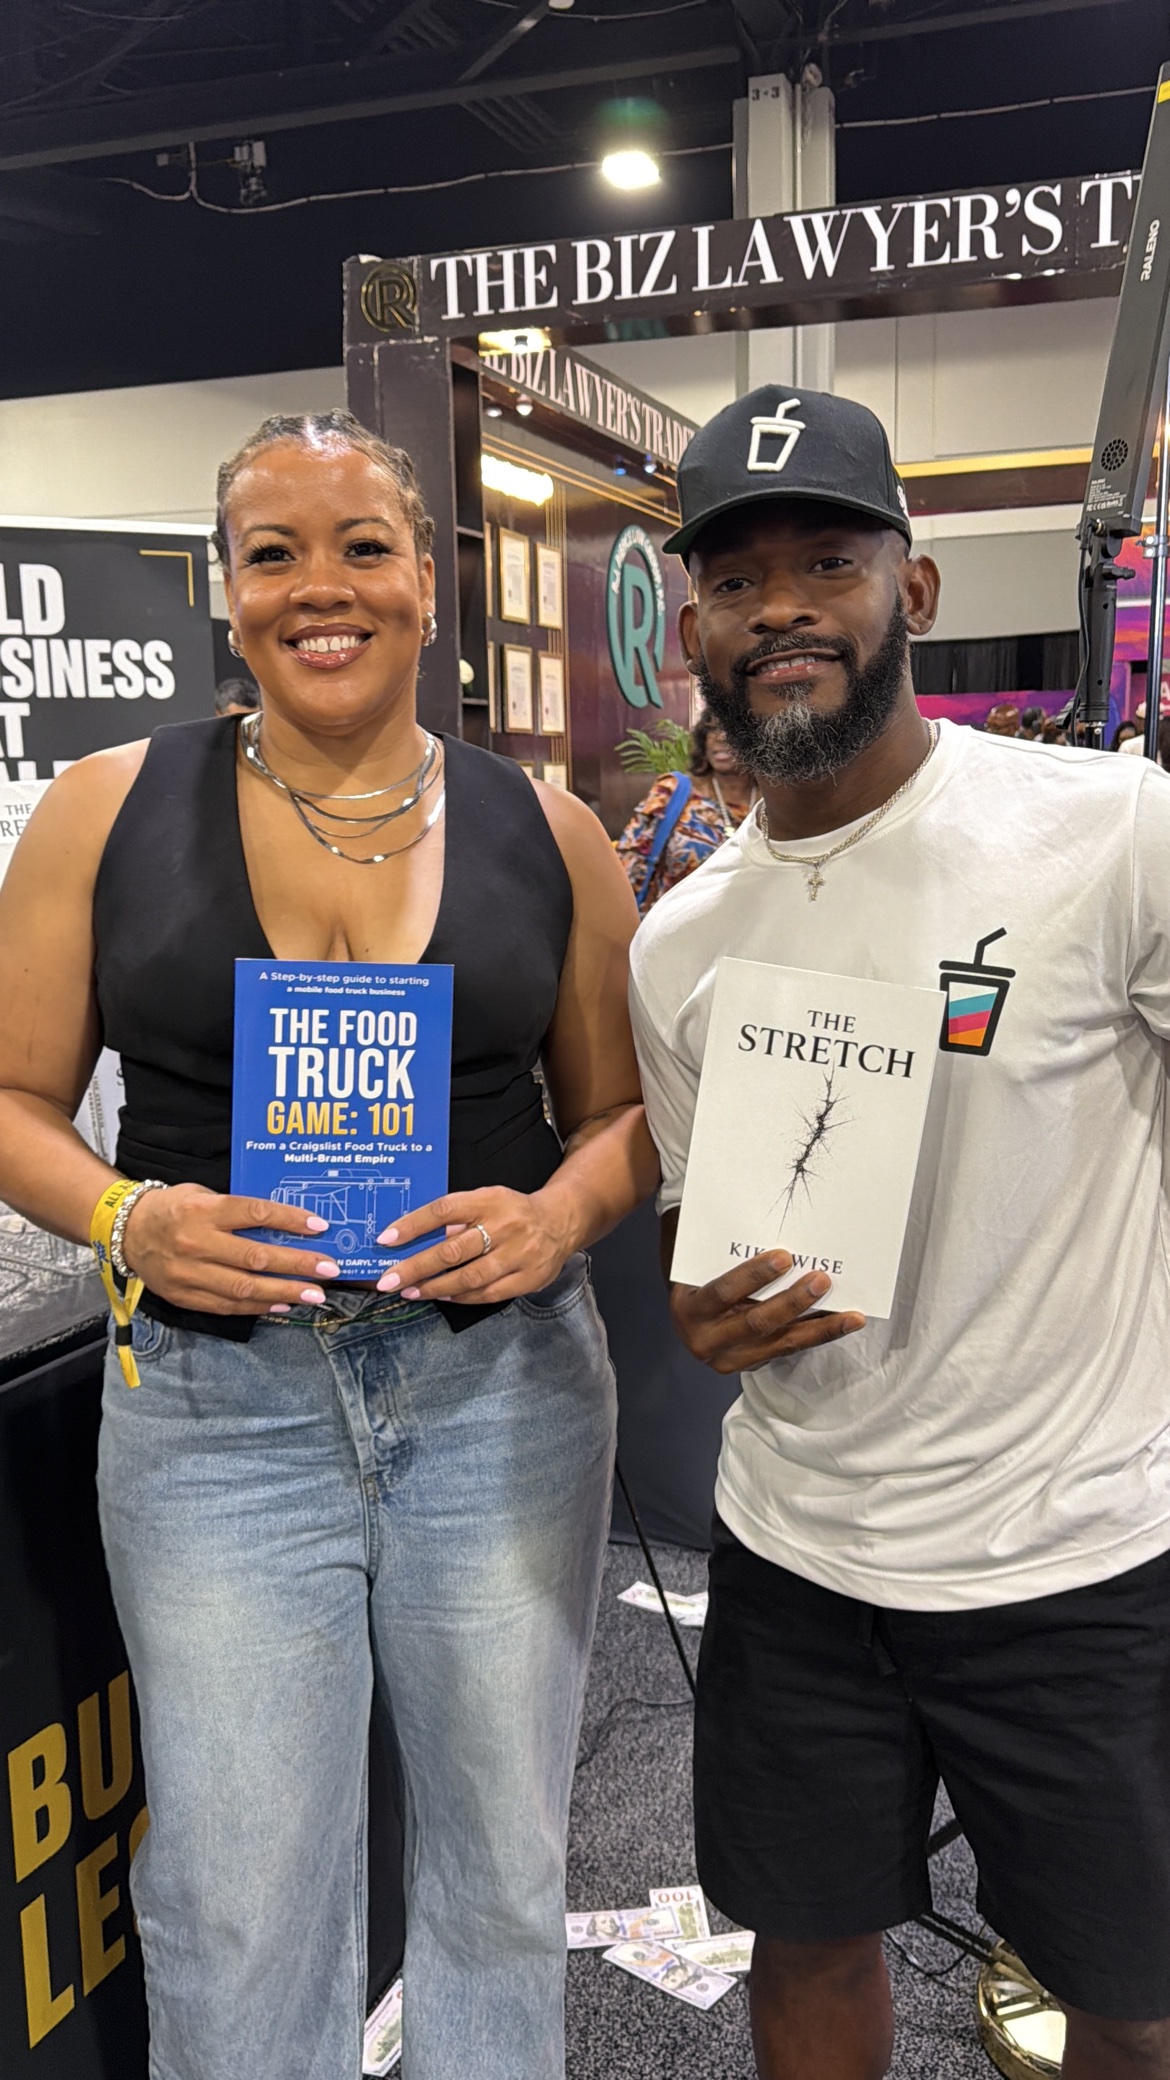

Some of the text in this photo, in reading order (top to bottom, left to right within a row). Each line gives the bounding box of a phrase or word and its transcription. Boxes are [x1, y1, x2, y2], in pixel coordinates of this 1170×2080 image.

[430, 173, 1143, 320] THE BIZ LAWYER'S T
[1140, 218, 1160, 282] RALENO
[548, 348, 642, 447] LAWYER'S
[259, 971, 430, 987] A Step-by-step guide to starting
[294, 986, 323, 994] mobile
[324, 986, 344, 995] food
[345, 987, 367, 995] truck
[369, 988, 406, 996] business
[269, 1008, 417, 1047] THE FOOD
[806, 1009, 857, 1034] THE
[737, 1024, 917, 1079] STRETCH
[268, 1046, 416, 1100] TRUCK
[267, 1100, 414, 1136] GAME: 101
[246, 1141, 276, 1151] From
[289, 1141, 342, 1153] Craigslist
[344, 1142, 374, 1152] Food
[377, 1142, 408, 1152] Truck
[411, 1143, 423, 1152] to
[284, 1153, 395, 1165] Multi-Brand Empire
[791, 1253, 844, 1275] WISE
